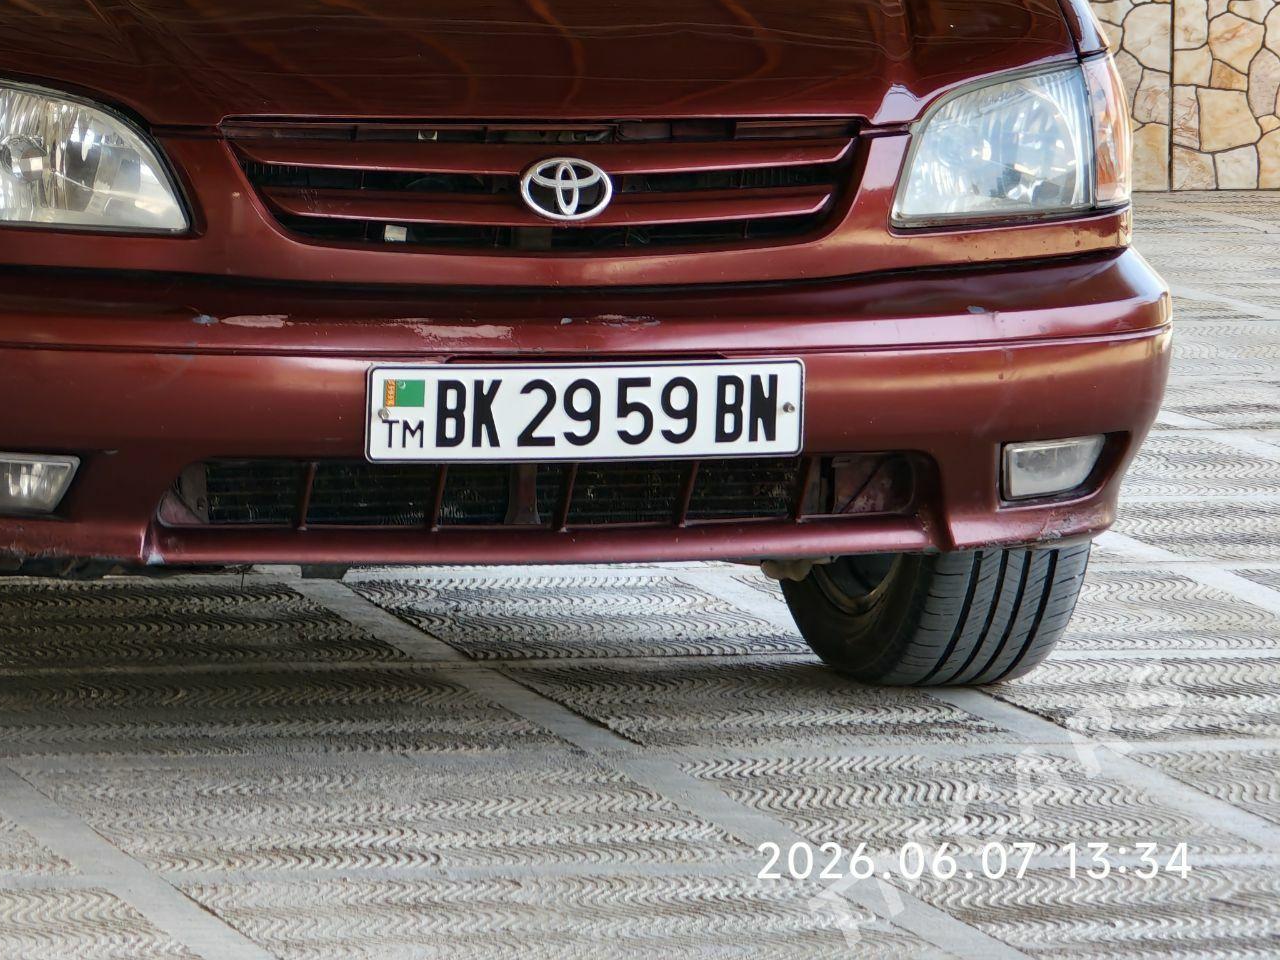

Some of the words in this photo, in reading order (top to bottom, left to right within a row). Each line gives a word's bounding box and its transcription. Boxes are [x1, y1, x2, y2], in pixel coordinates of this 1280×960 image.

[381, 419, 424, 449] TM
[435, 379, 503, 448] BK
[714, 374, 778, 443] BN
